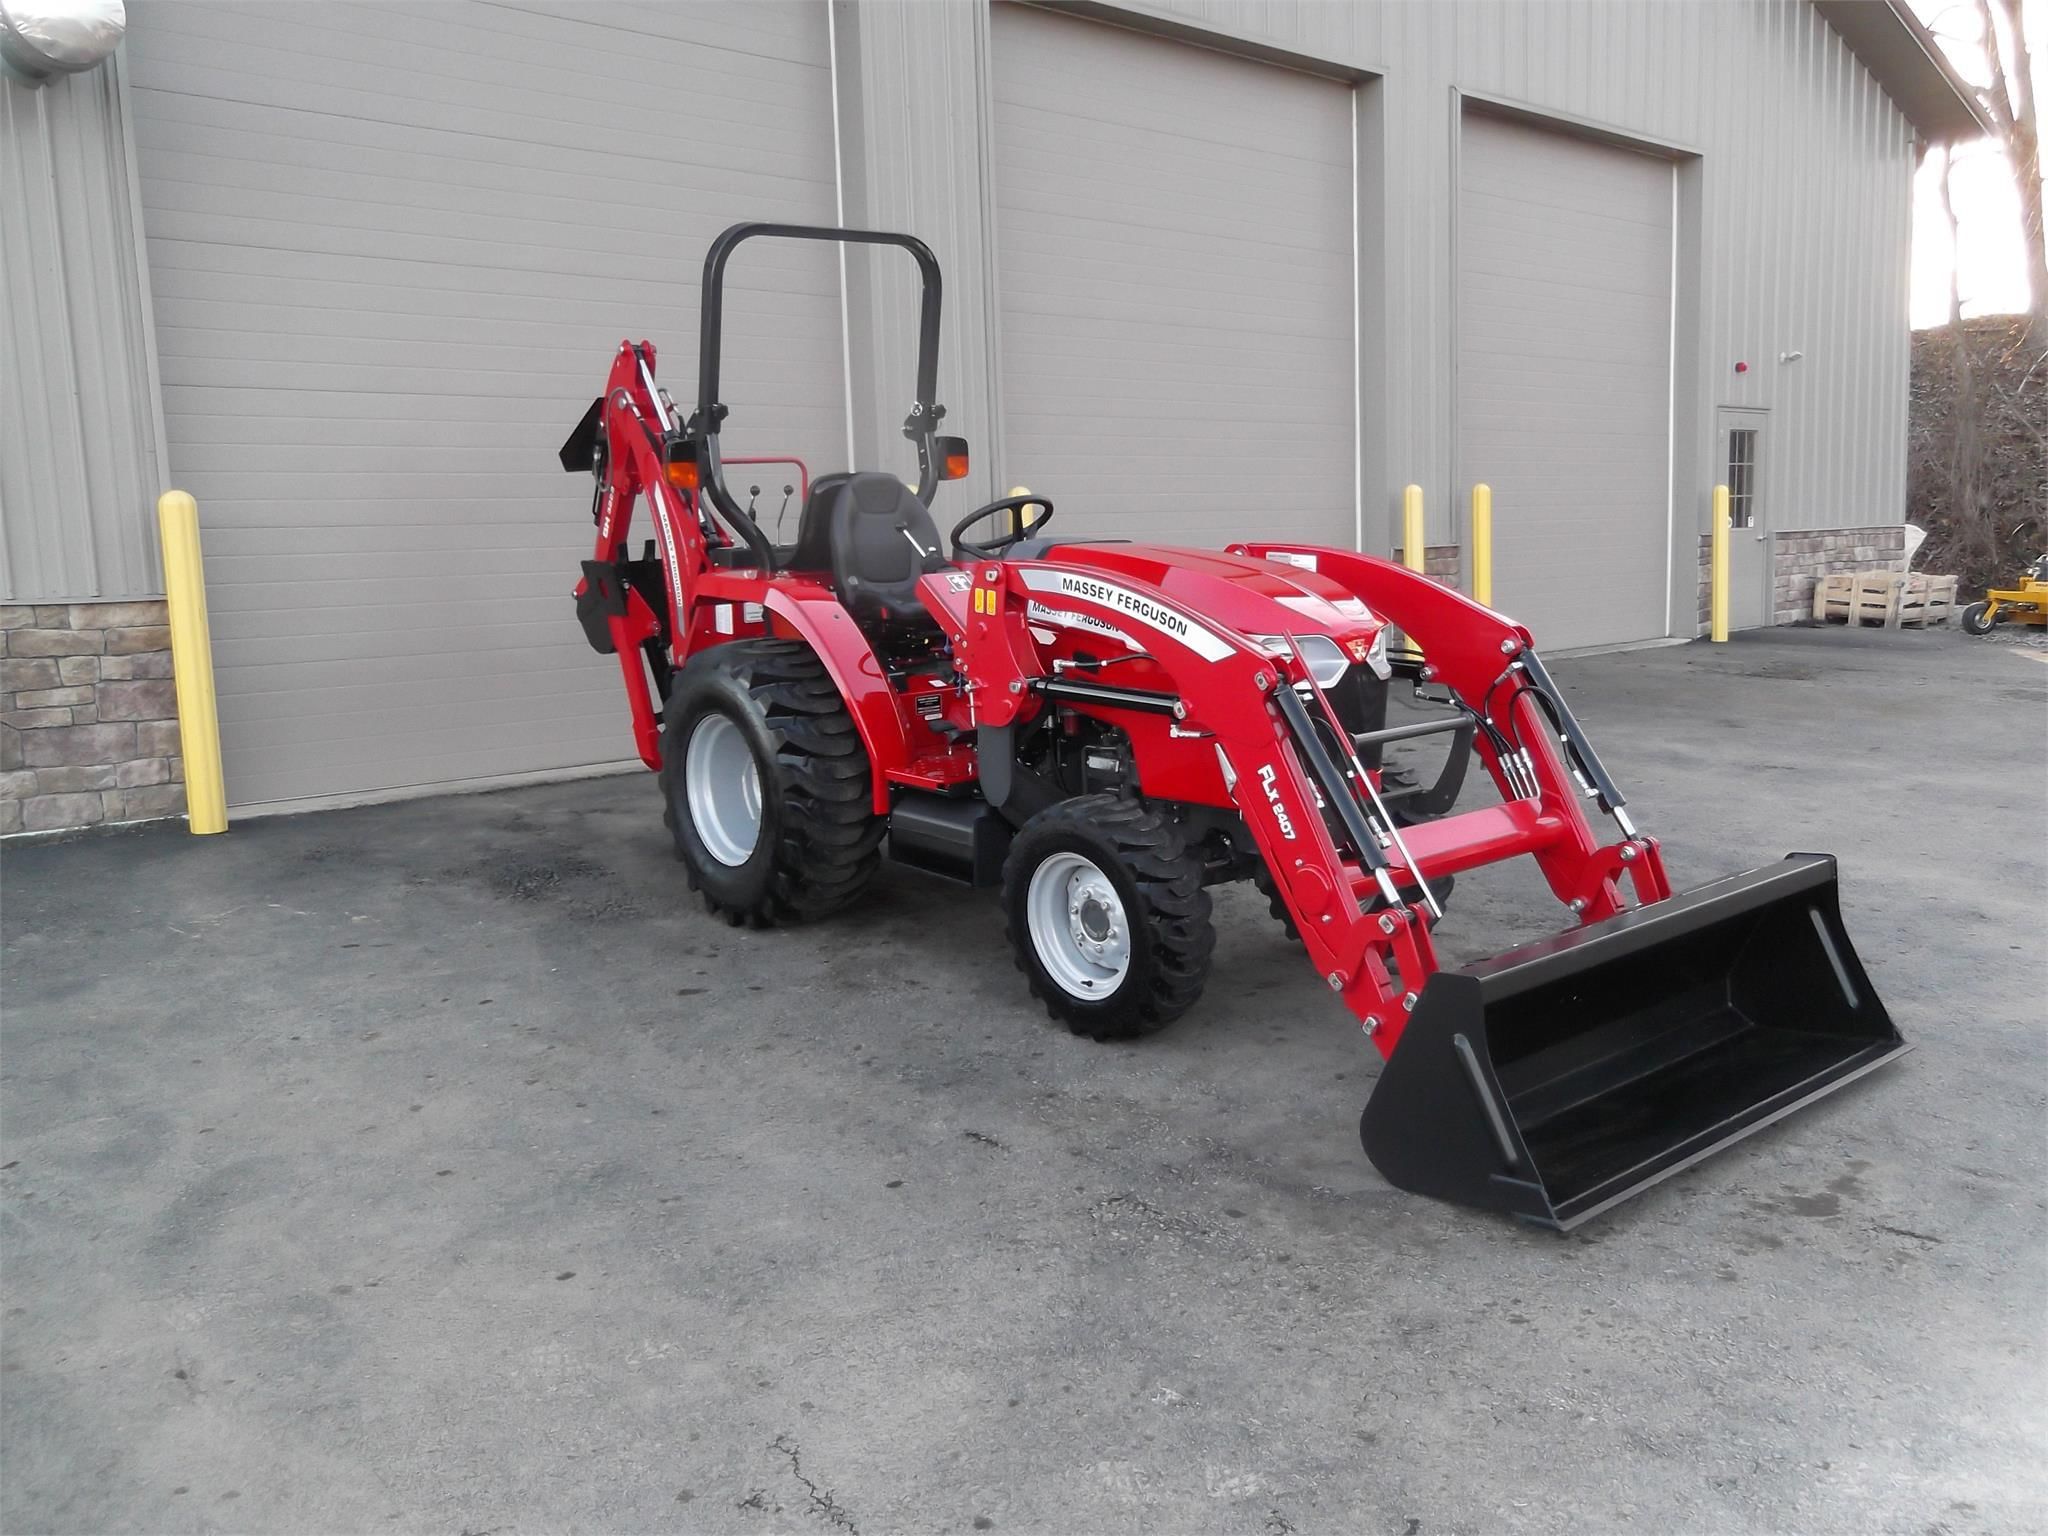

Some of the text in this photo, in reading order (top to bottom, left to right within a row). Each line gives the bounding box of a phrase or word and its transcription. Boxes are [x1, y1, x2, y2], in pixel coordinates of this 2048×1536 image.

[1062, 577, 1188, 637] MASSEY FERGUSON
[1272, 803, 1296, 839] 2407
